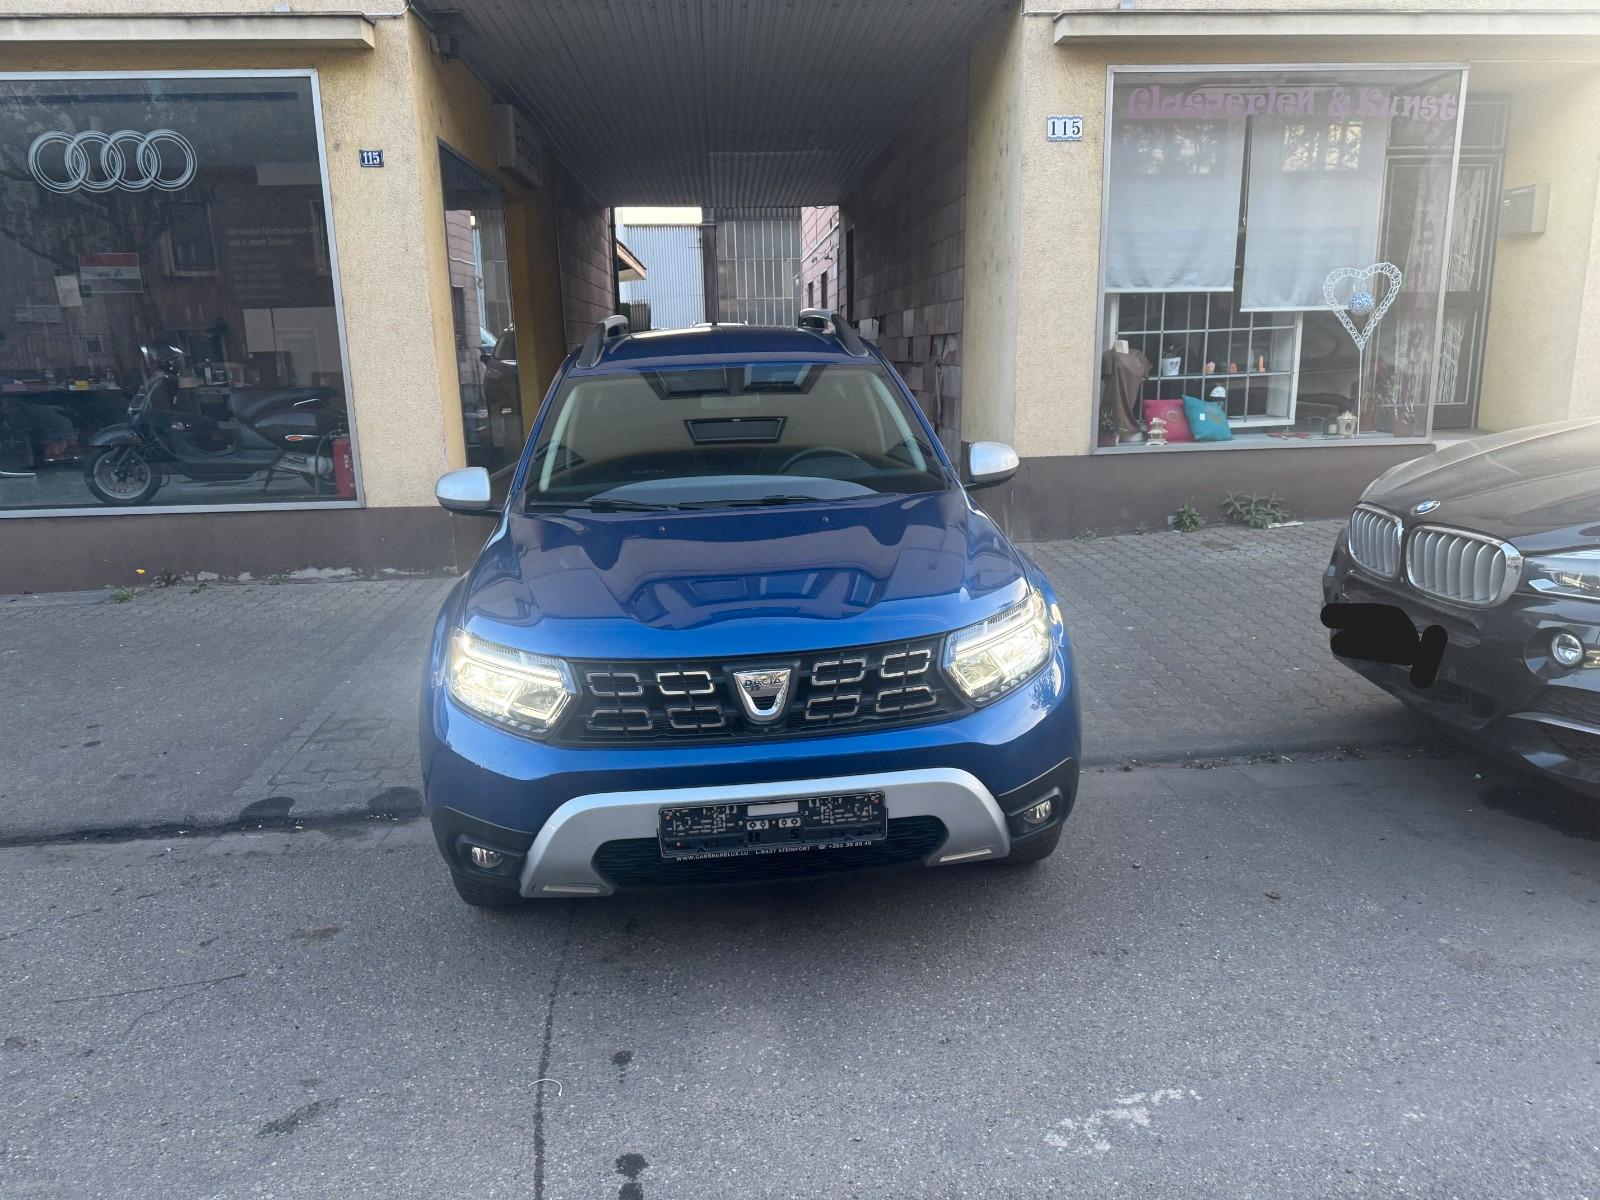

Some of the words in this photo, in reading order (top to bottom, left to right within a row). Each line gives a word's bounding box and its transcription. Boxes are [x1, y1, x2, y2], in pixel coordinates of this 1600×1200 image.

[1127, 86, 1314, 118] Glasperlen
[1326, 86, 1350, 119] &
[1358, 87, 1457, 120] Kunst
[1050, 120, 1081, 136] 115
[362, 151, 380, 165] 115
[744, 676, 782, 688] DACIA
